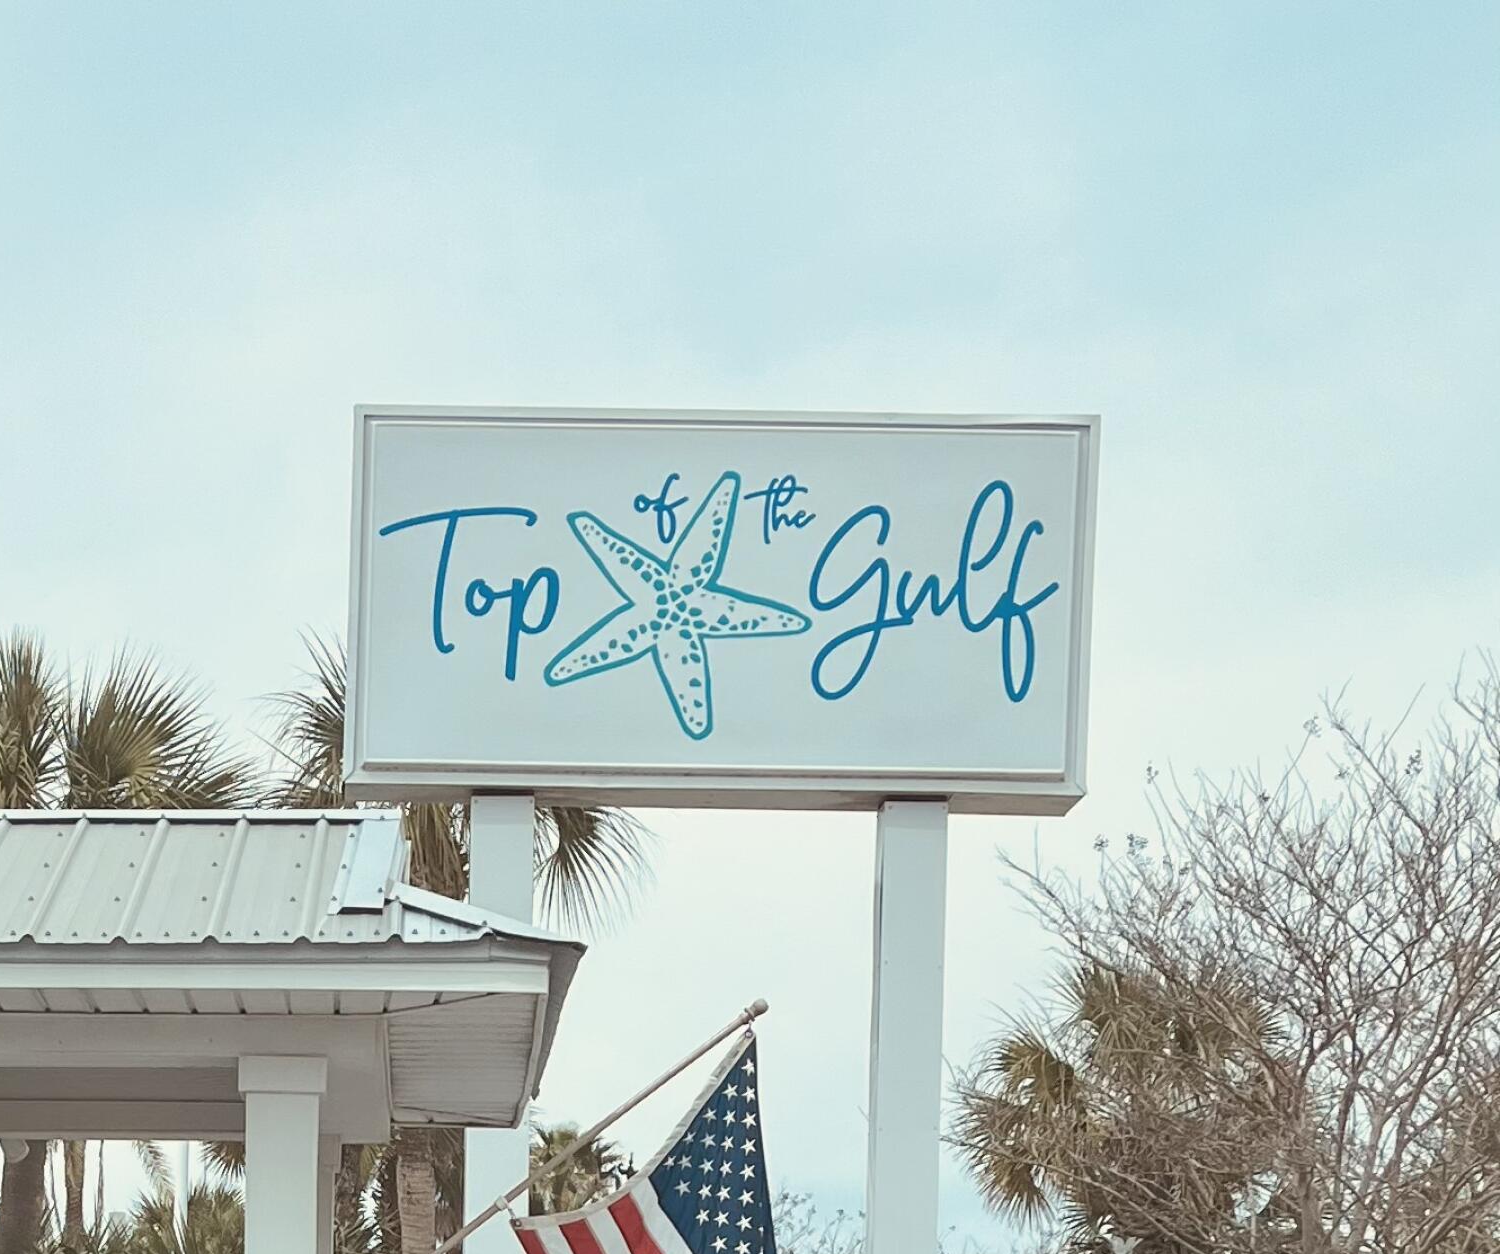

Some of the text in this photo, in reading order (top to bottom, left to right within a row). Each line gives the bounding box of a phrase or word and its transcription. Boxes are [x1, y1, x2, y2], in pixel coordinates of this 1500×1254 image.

[379, 472, 1060, 704] Top of the Gulf
